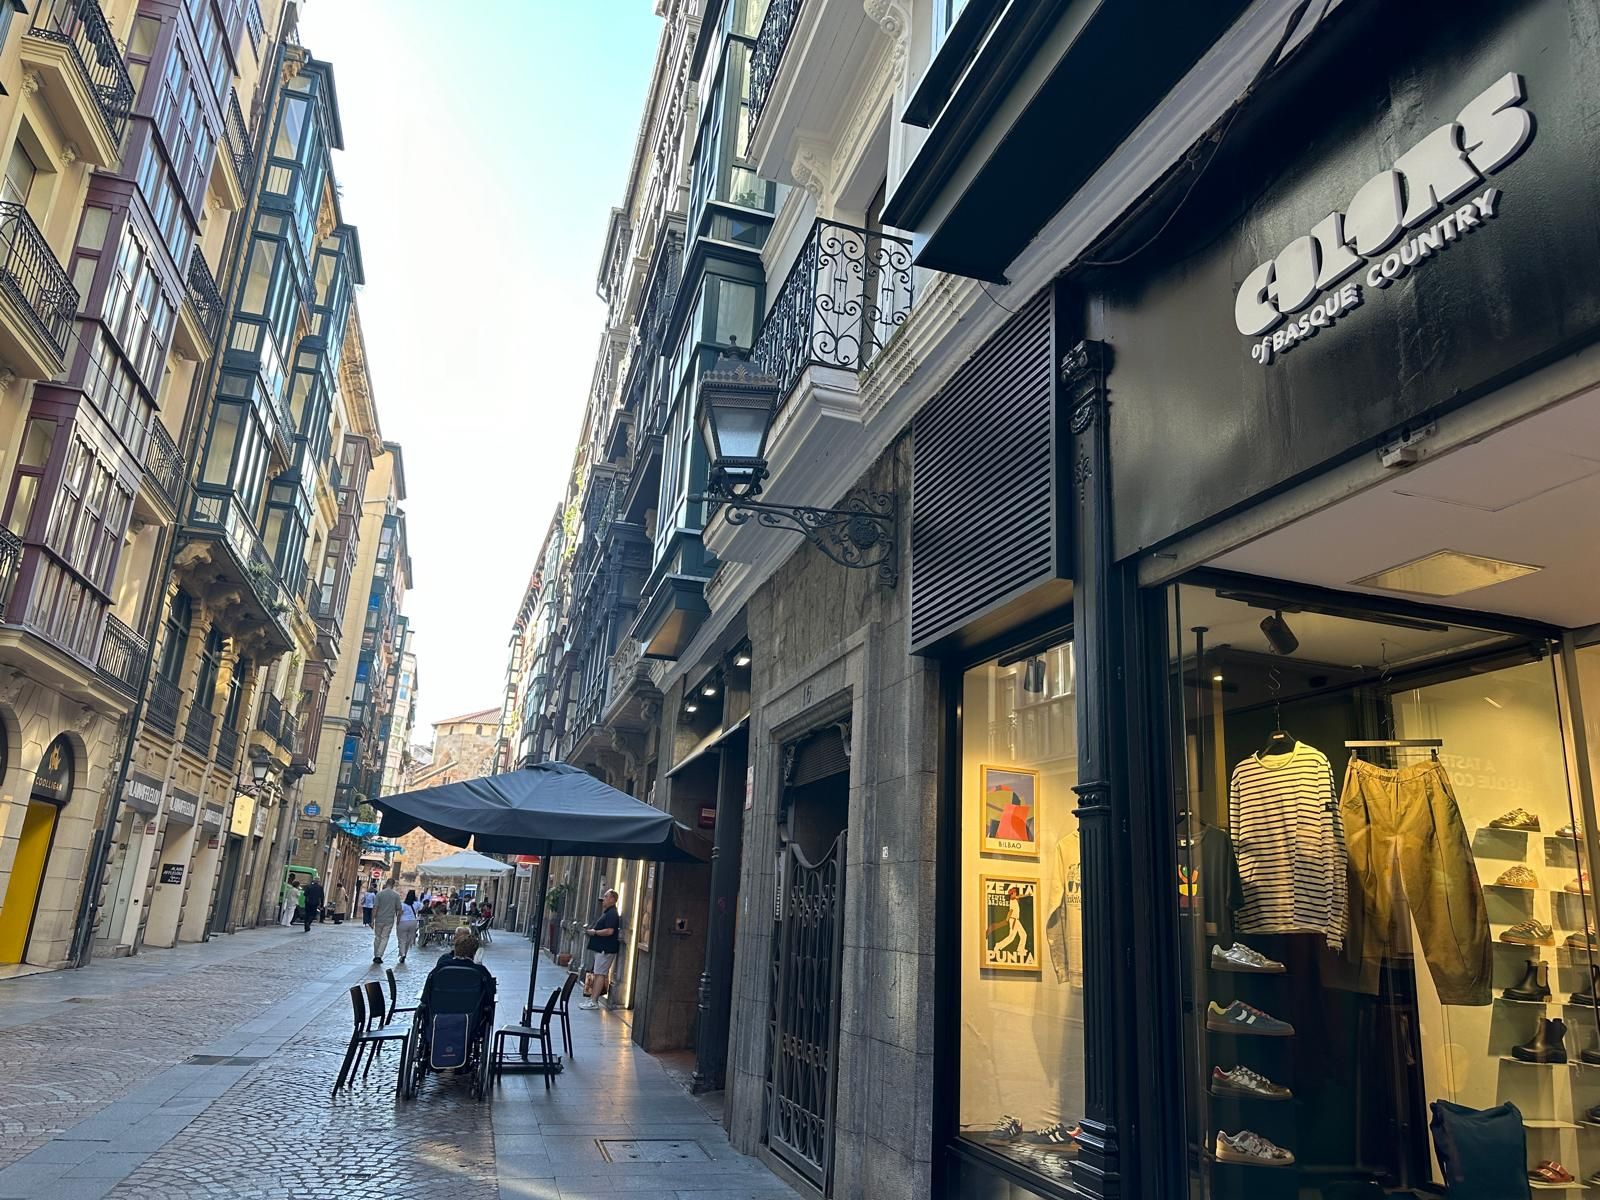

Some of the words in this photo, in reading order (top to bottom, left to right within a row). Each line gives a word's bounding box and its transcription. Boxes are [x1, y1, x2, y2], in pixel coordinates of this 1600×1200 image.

[1251, 336, 1273, 364] of
[1272, 282, 1360, 353] BASQUE
[1366, 187, 1500, 289] COUNTRY
[998, 841, 1022, 849] BILBAO
[986, 949, 1035, 964] PUNTA
